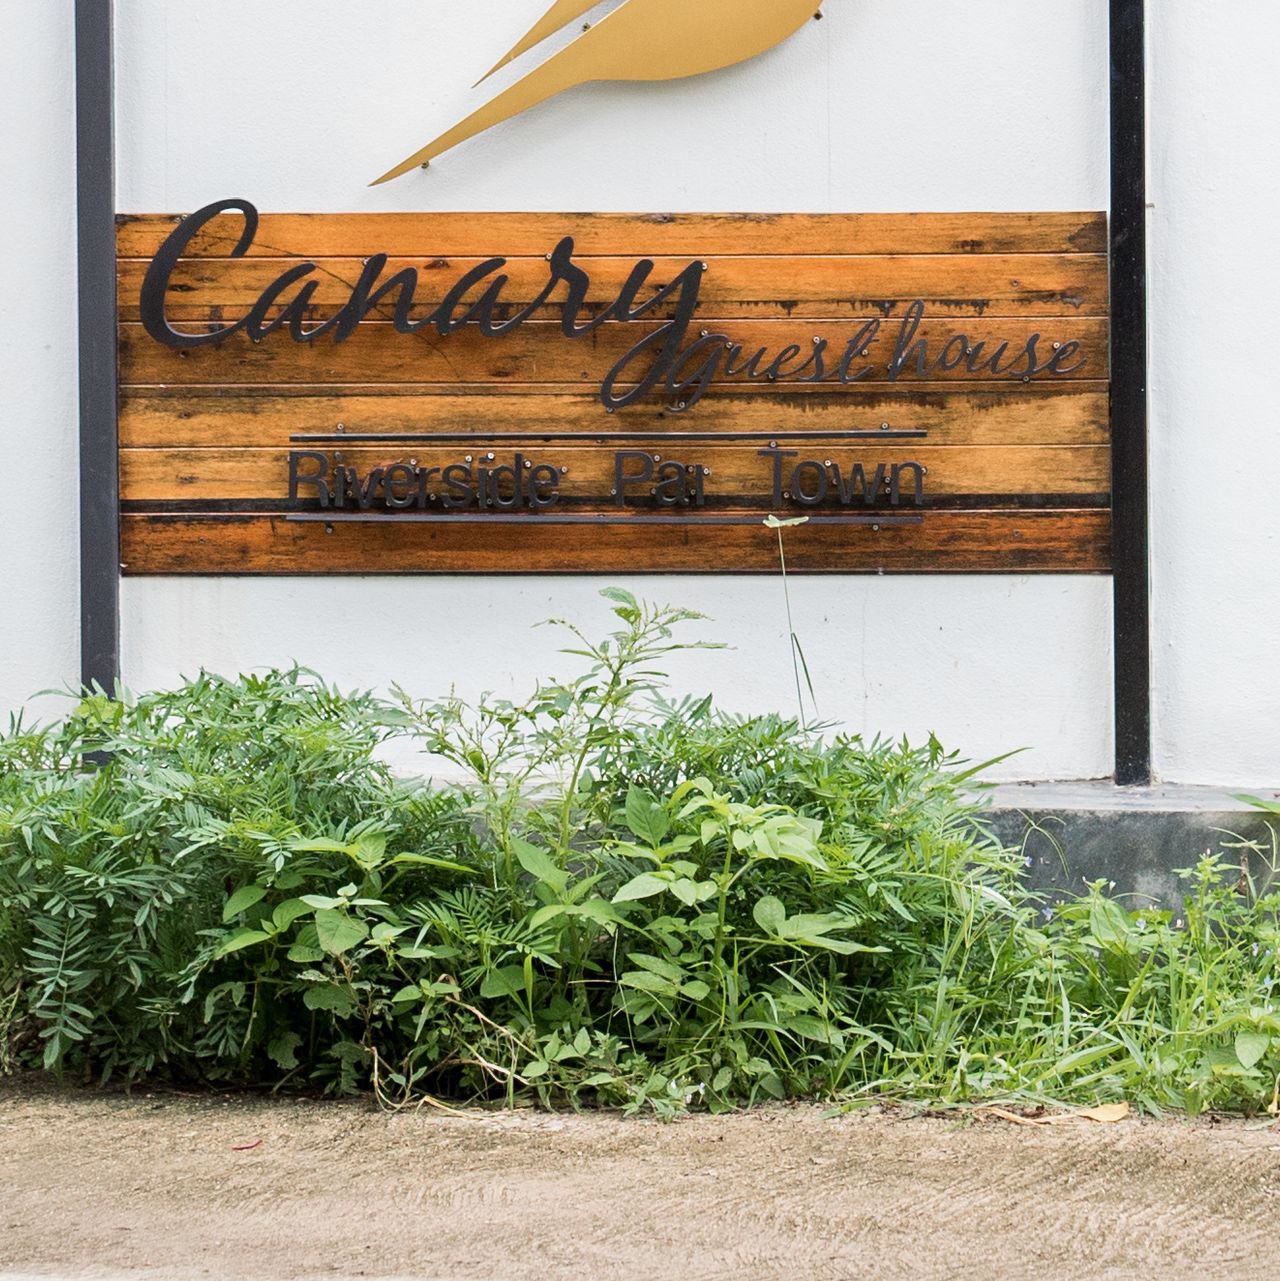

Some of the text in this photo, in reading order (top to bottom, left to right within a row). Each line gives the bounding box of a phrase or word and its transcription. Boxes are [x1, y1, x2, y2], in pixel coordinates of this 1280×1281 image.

[139, 198, 705, 412] Canary
[287, 450, 560, 509] Riverside
[757, 447, 925, 506] Town
